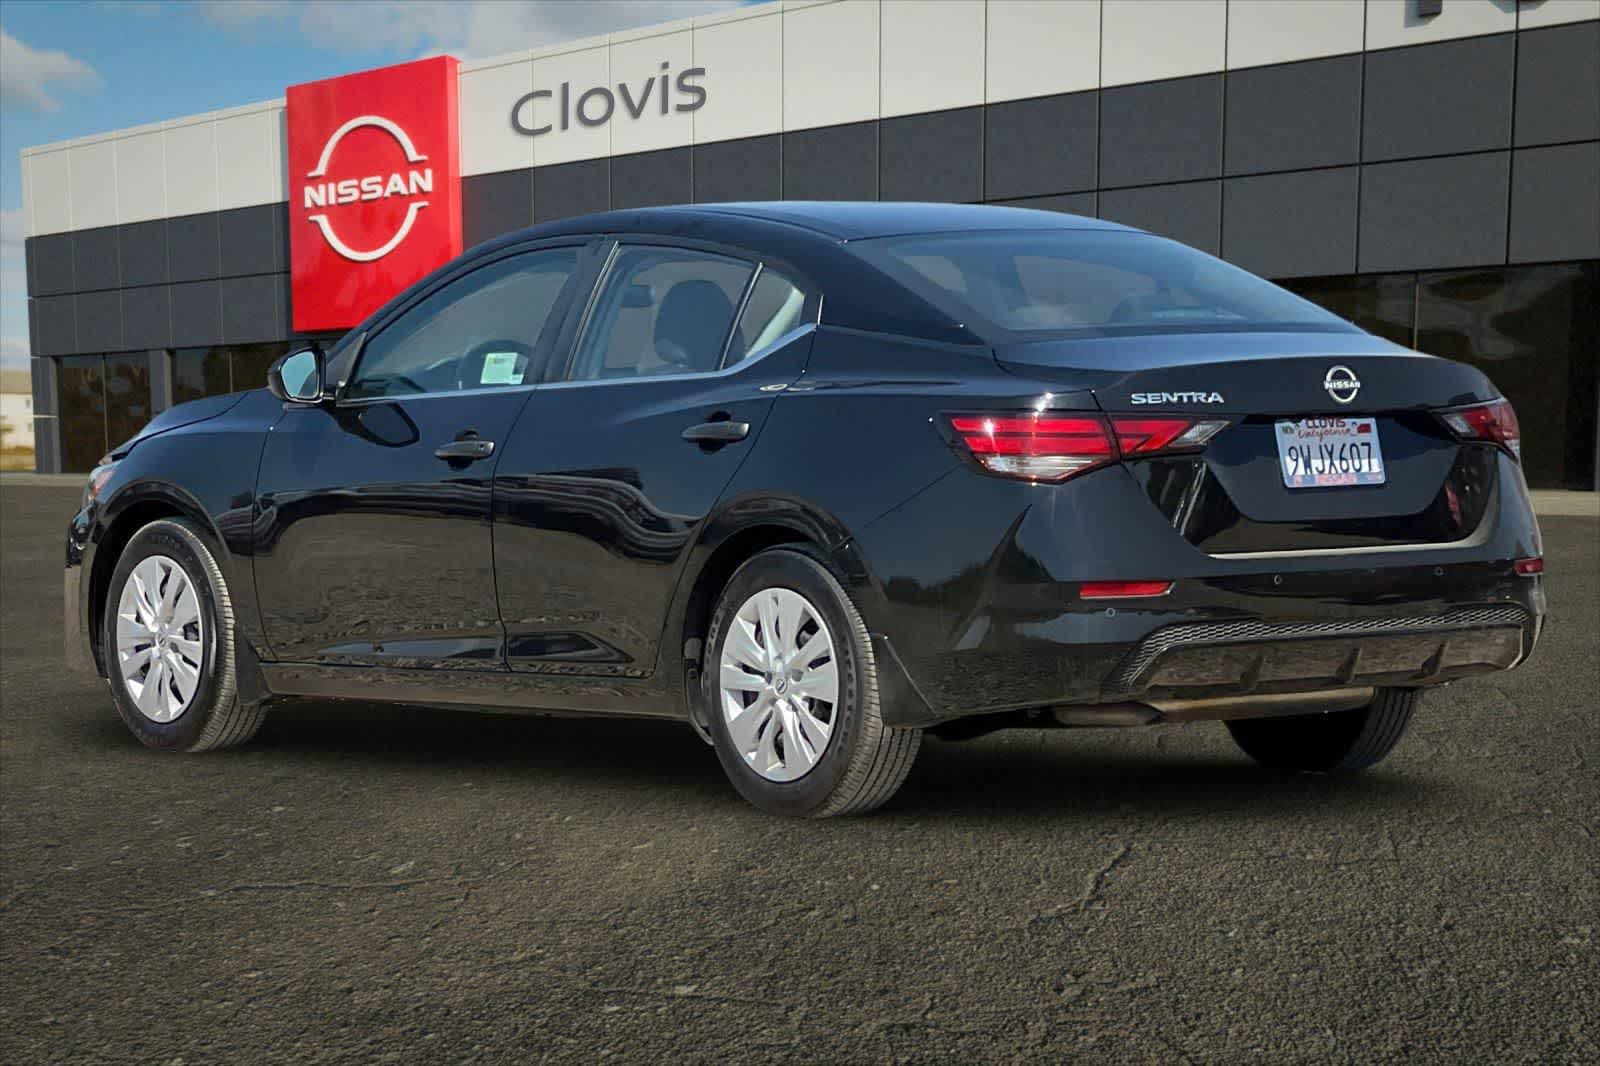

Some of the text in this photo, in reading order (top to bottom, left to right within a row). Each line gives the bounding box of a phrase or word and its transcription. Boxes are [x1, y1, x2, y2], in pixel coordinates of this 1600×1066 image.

[511, 61, 708, 136] Clovis
[304, 168, 433, 208] NISSAN
[1130, 391, 1225, 405] SENTRA
[1323, 380, 1361, 390] NISSAN
[1288, 442, 1372, 476] 9WJX607
